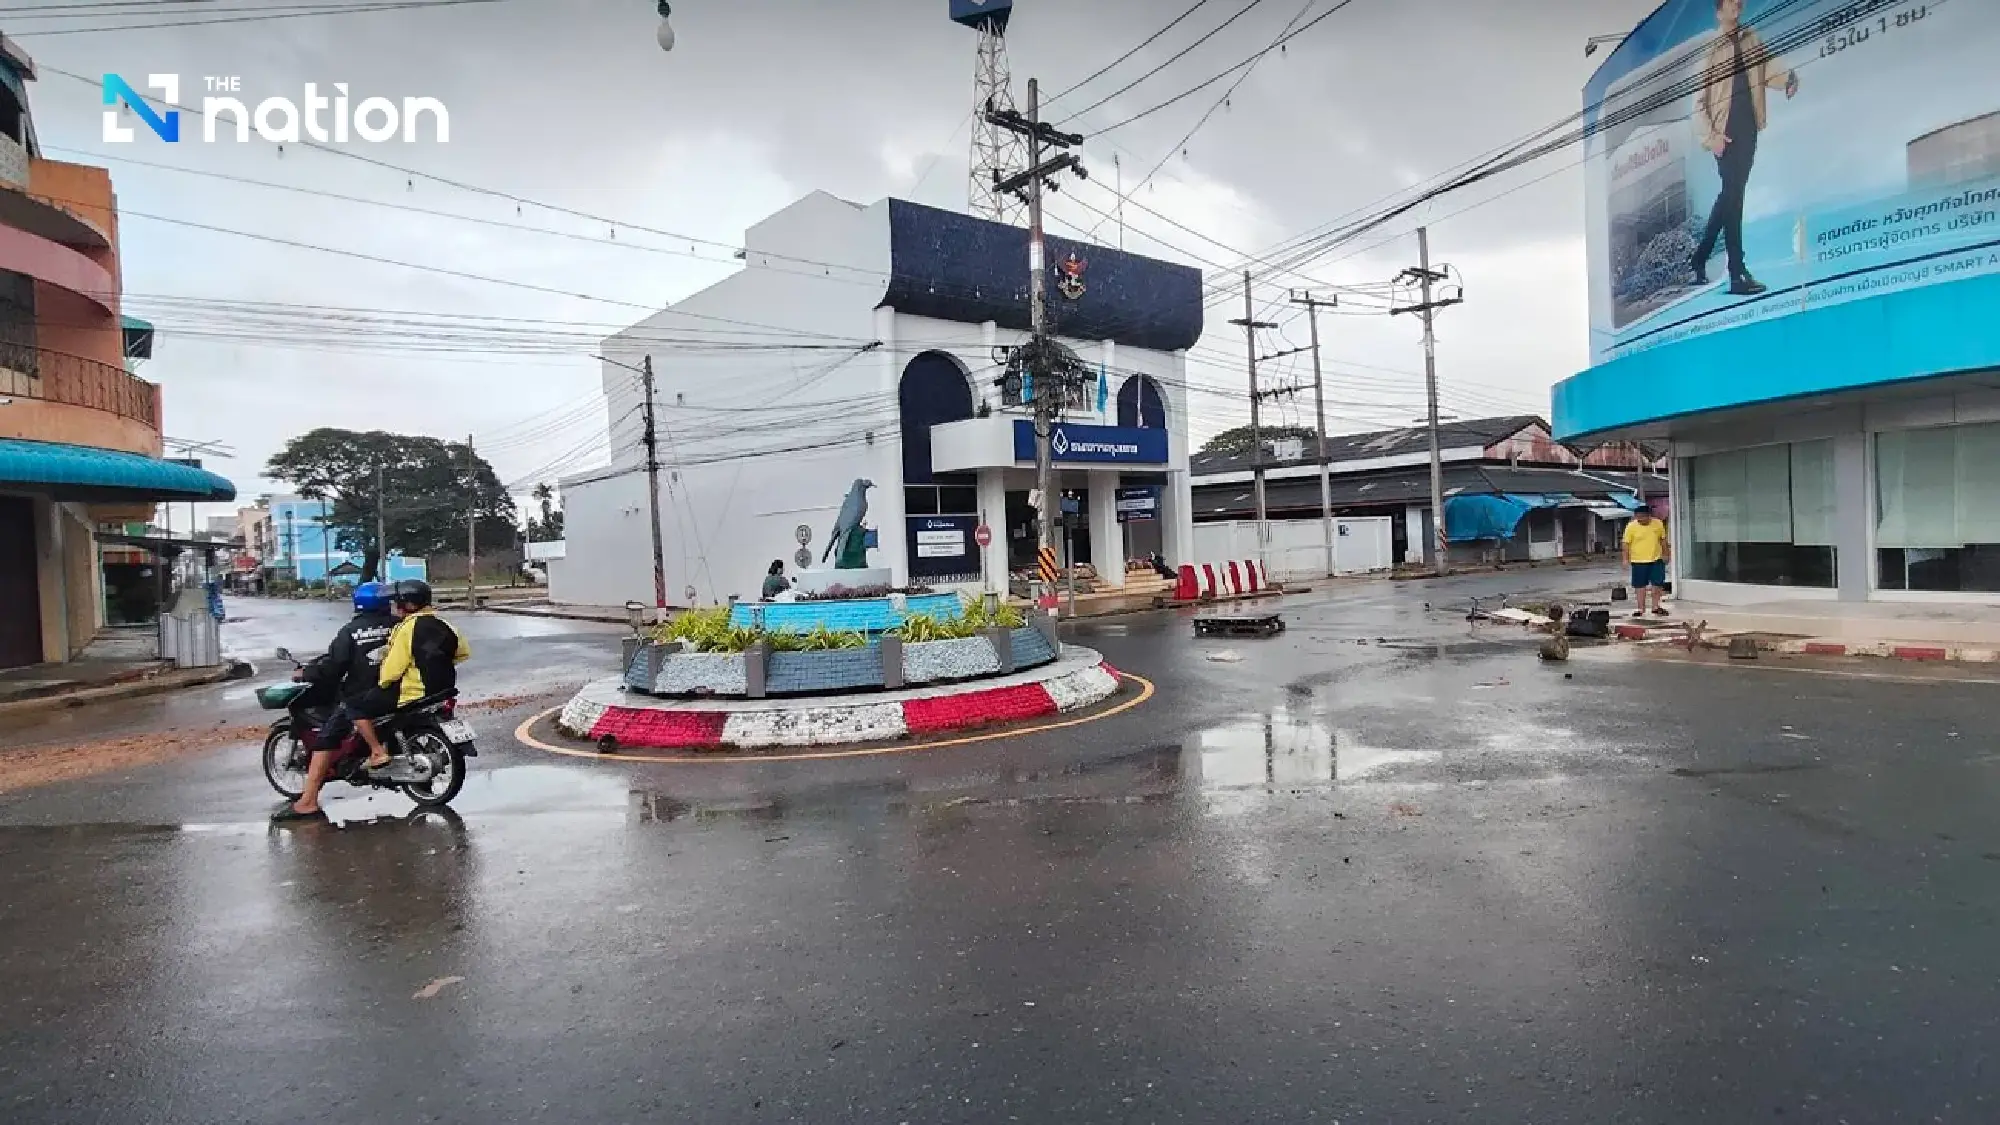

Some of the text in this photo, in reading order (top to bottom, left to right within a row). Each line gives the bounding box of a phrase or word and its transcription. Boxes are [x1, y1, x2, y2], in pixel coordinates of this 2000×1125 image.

[1877, 17, 1886, 33] 1
[1818, 210, 1995, 261] กรรมการผู้จัดการ บริษัท
[1934, 256, 1983, 276] SMART
